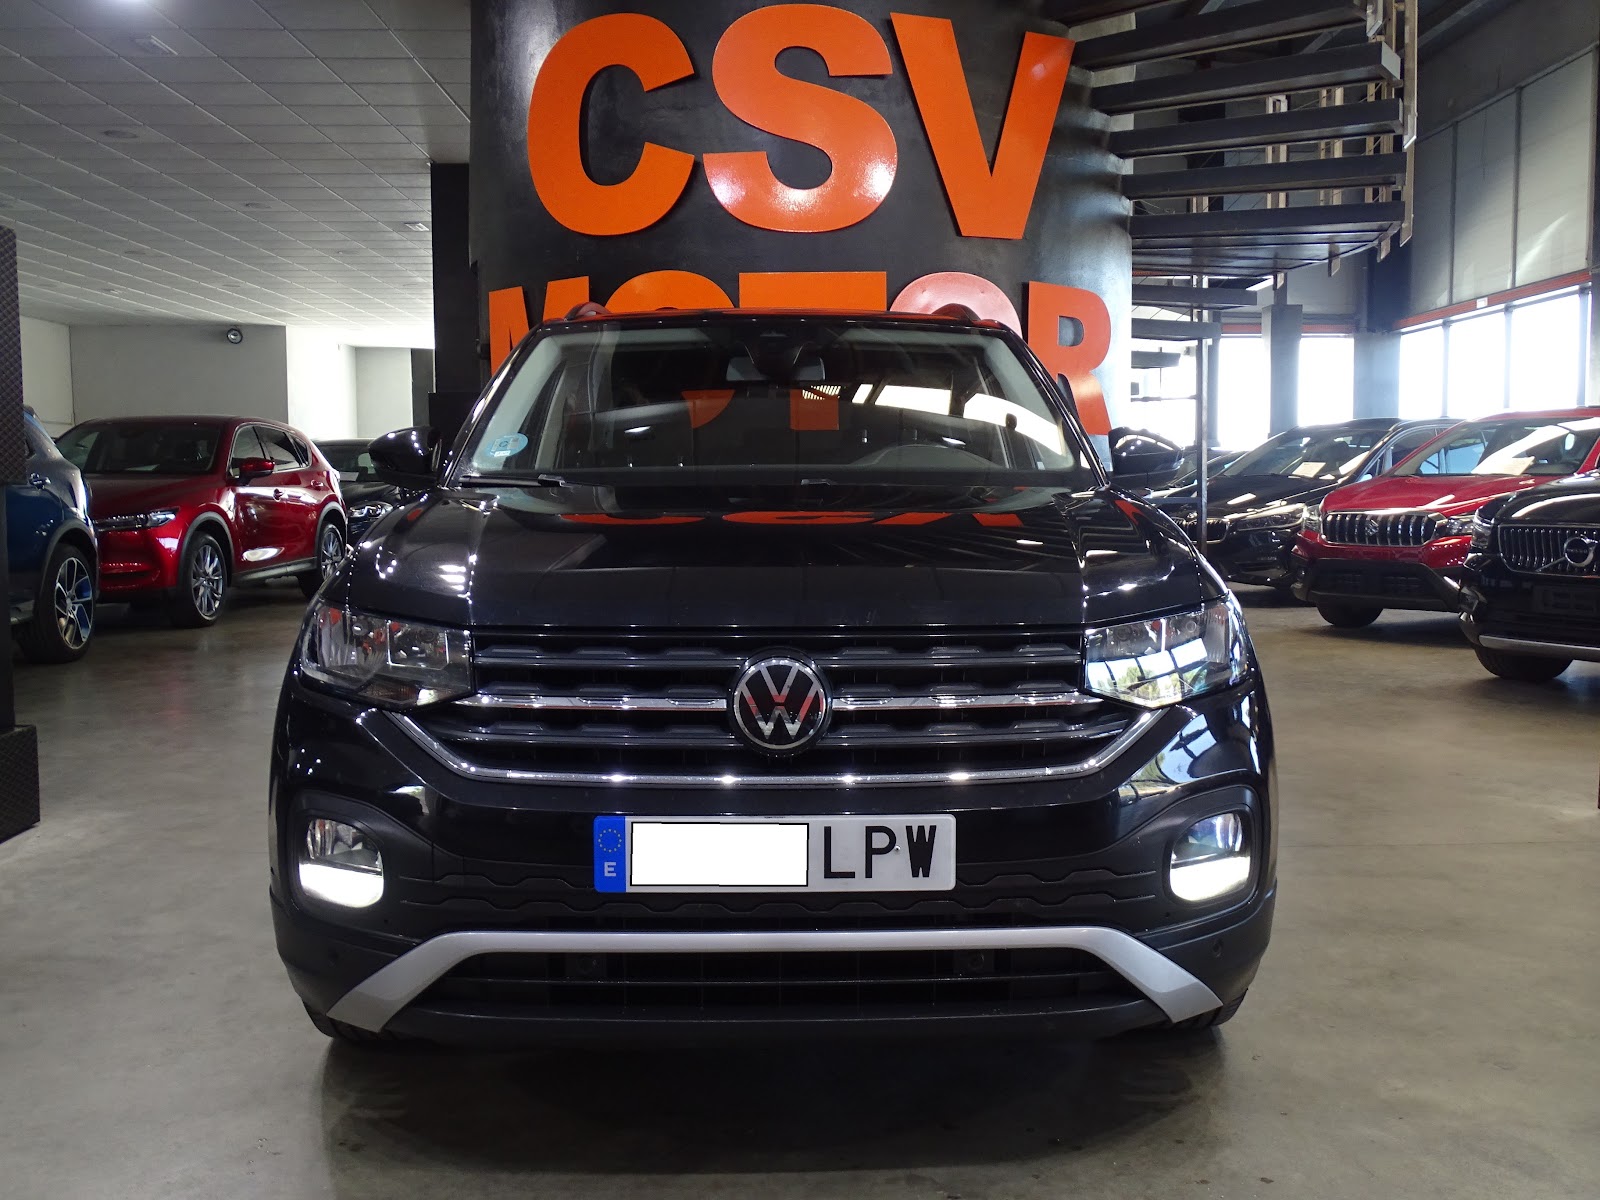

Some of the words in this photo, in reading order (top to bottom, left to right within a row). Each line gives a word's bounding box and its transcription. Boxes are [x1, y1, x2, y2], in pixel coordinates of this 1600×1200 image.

[527, 3, 1075, 240] CSV
[603, 861, 617, 877] E
[823, 824, 937, 879] LPW
